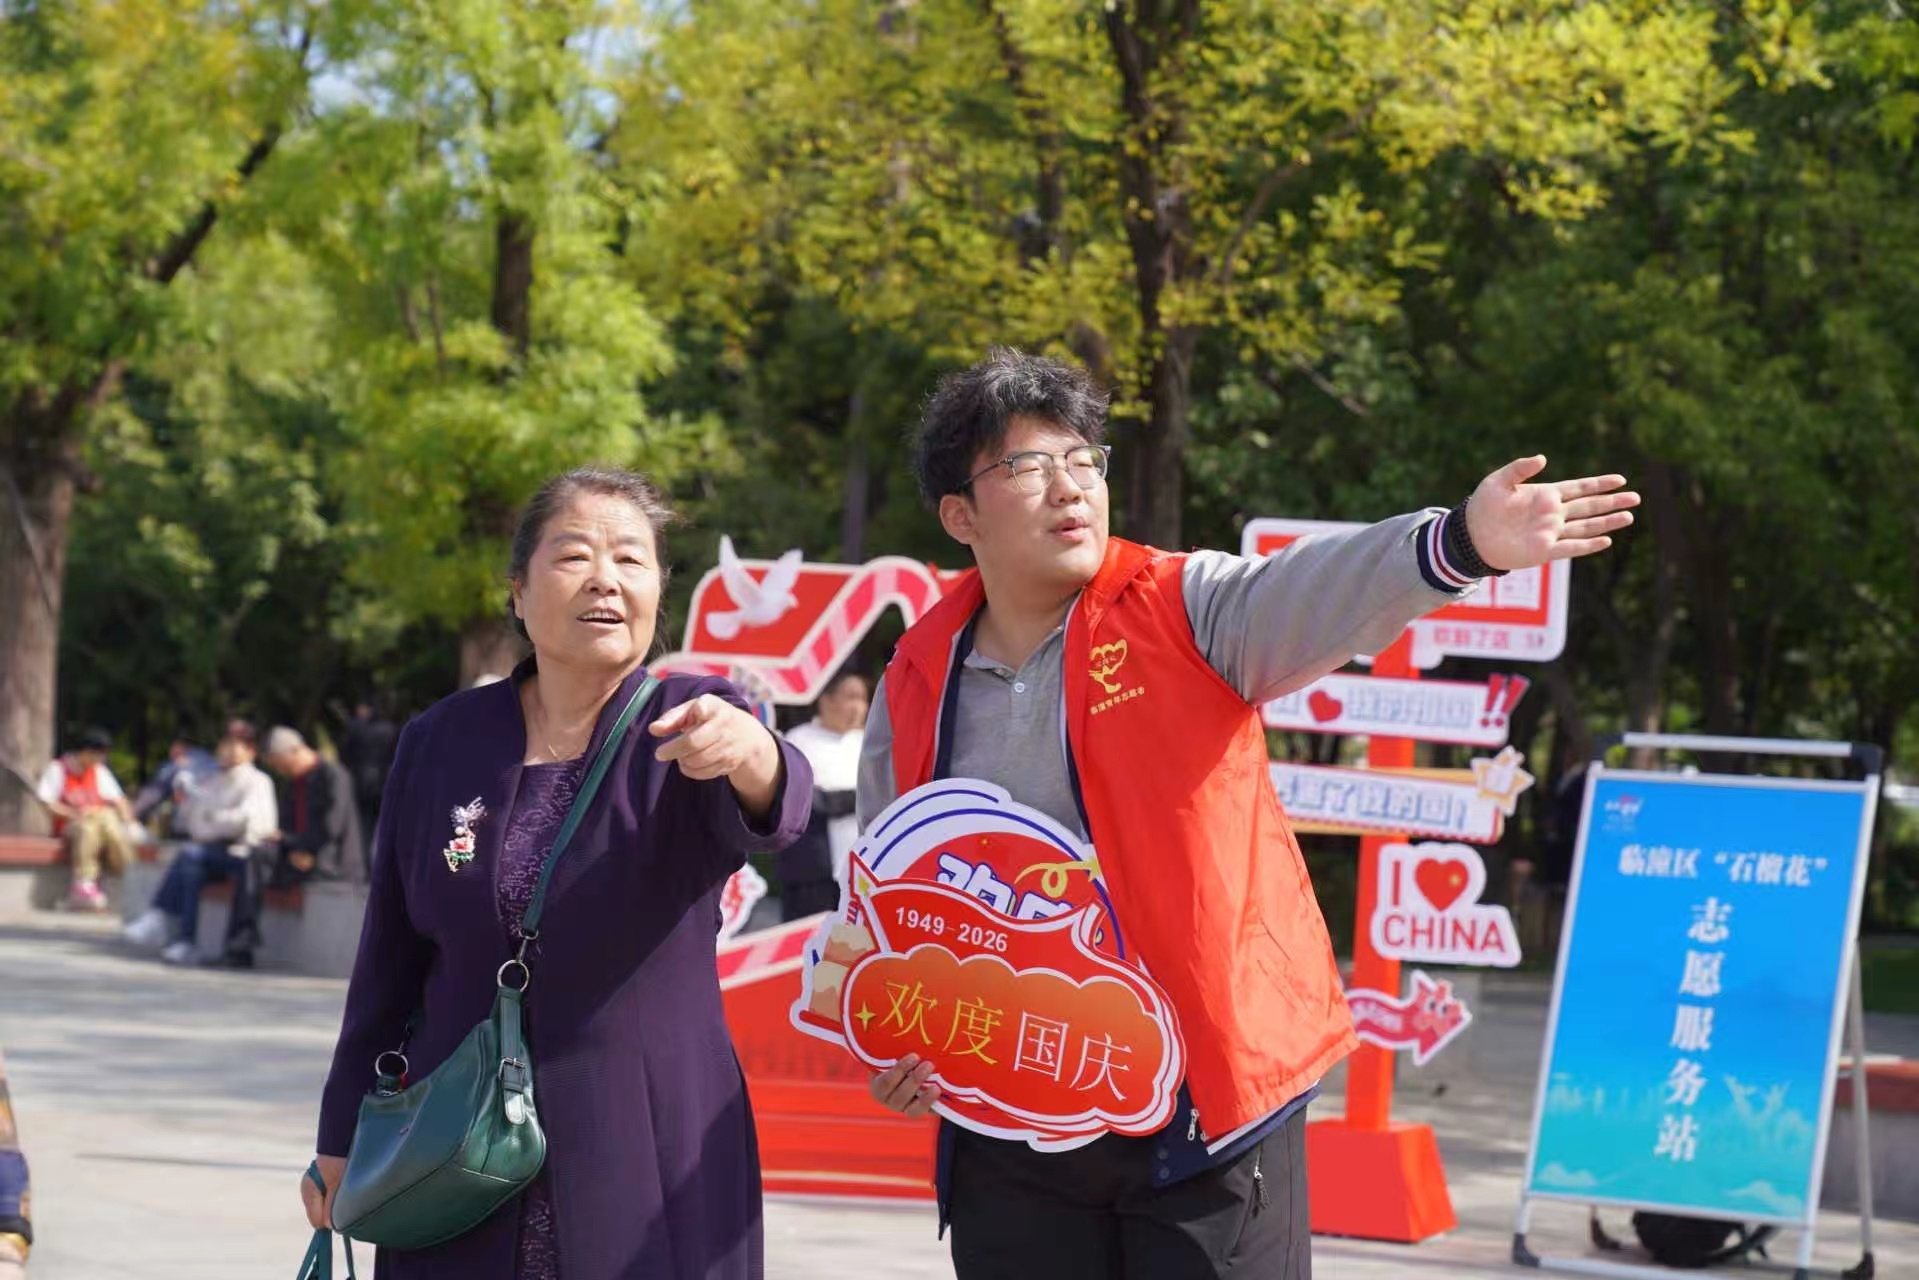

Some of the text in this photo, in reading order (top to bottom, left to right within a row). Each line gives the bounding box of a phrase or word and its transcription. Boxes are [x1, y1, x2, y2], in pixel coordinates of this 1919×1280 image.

[1391, 860, 1400, 906] I
[895, 906, 1009, 953] 1949-2026
[1382, 914, 1506, 954] CHINA
[878, 979, 1133, 1102] 欢度国庆
[1653, 897, 1735, 1162] 志愿服务站
